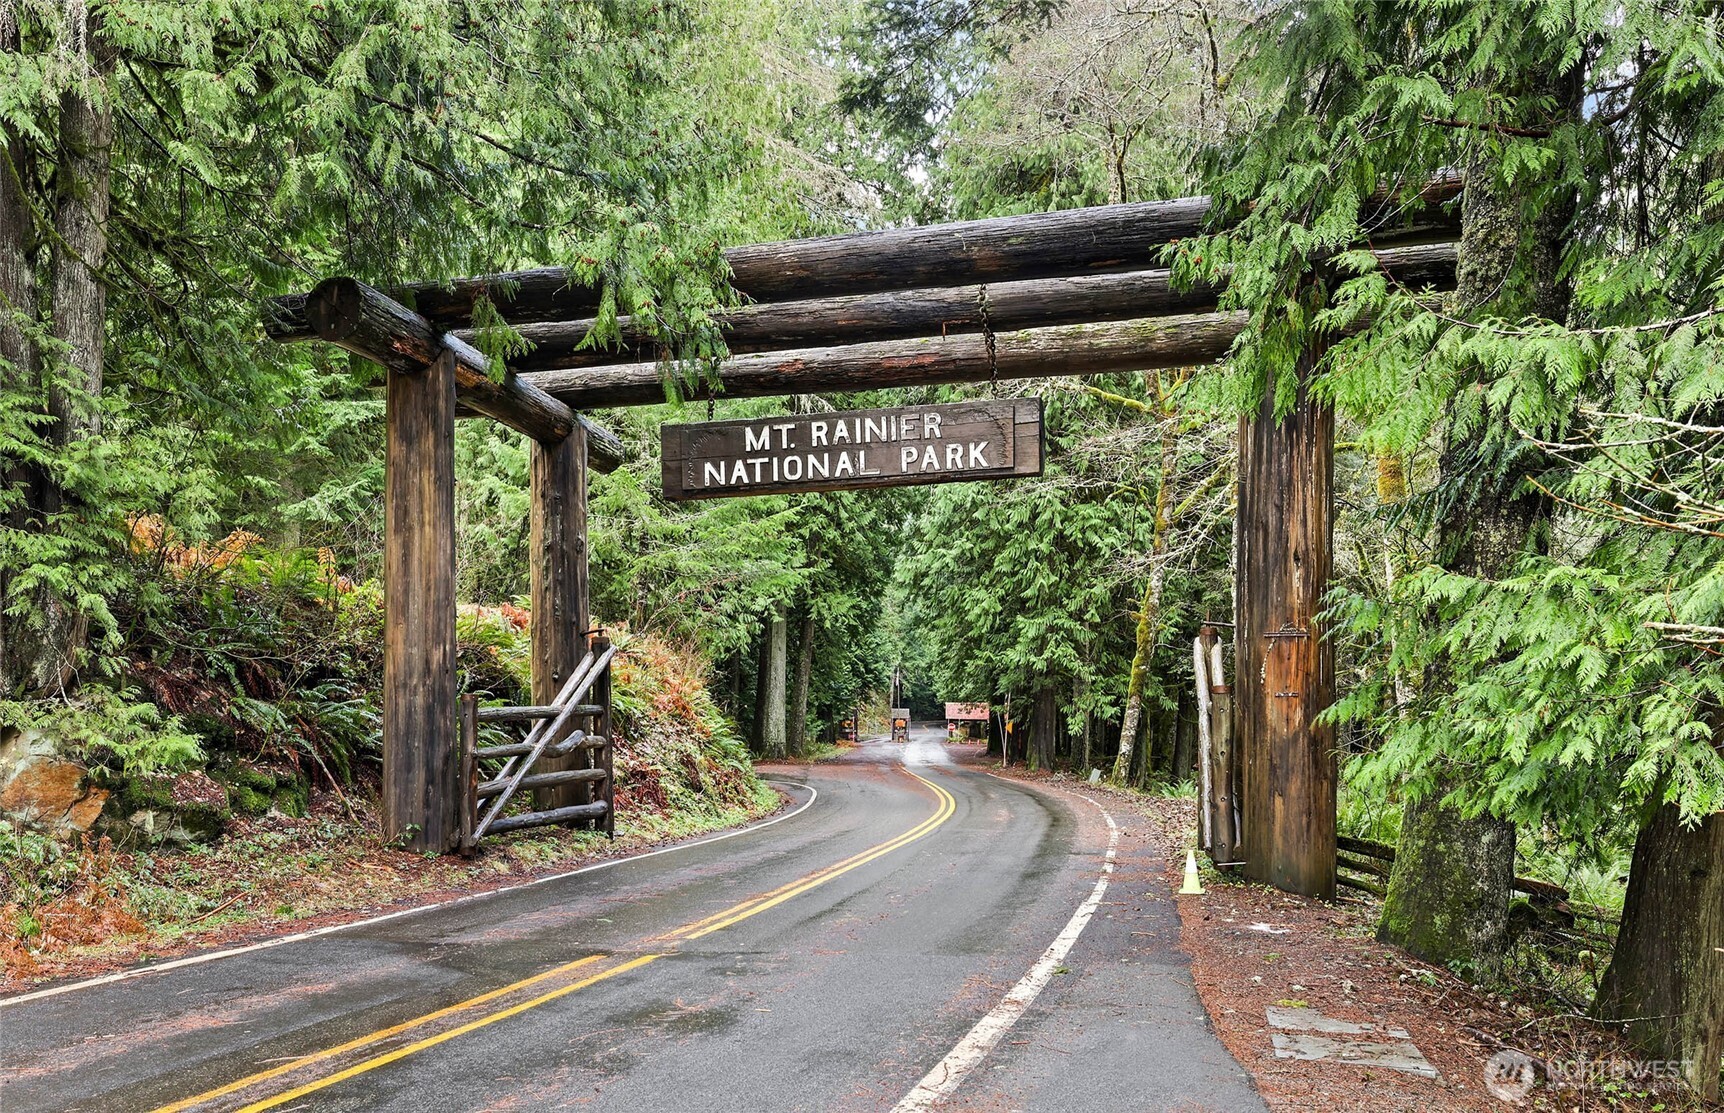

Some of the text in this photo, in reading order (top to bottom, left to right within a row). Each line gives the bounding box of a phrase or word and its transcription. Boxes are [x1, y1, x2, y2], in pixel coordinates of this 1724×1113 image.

[744, 412, 943, 453] MT. RAINIER
[703, 440, 991, 487] NATIONAL PARK
